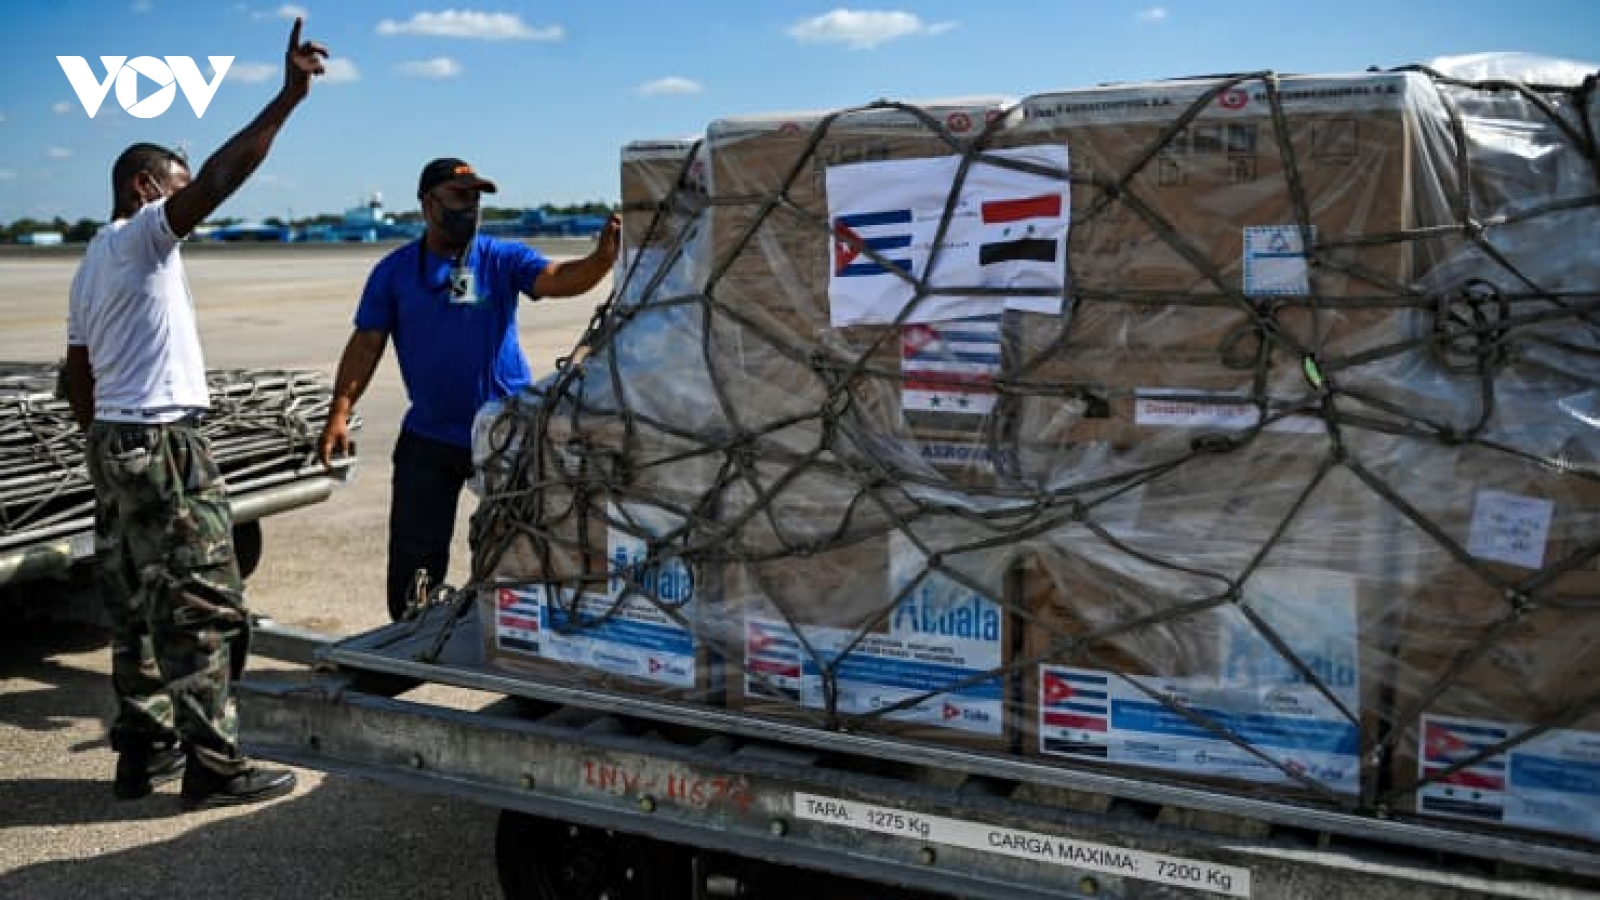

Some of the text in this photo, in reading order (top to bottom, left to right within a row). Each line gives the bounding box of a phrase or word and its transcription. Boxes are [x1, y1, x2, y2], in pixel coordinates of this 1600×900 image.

[867, 809, 905, 830] 1275
[908, 816, 931, 838] Kg
[988, 831, 1054, 859] CARGA
[1058, 842, 1140, 873] MAXIMA:
[1157, 860, 1202, 882] 7200
[1206, 869, 1232, 889] Kg
